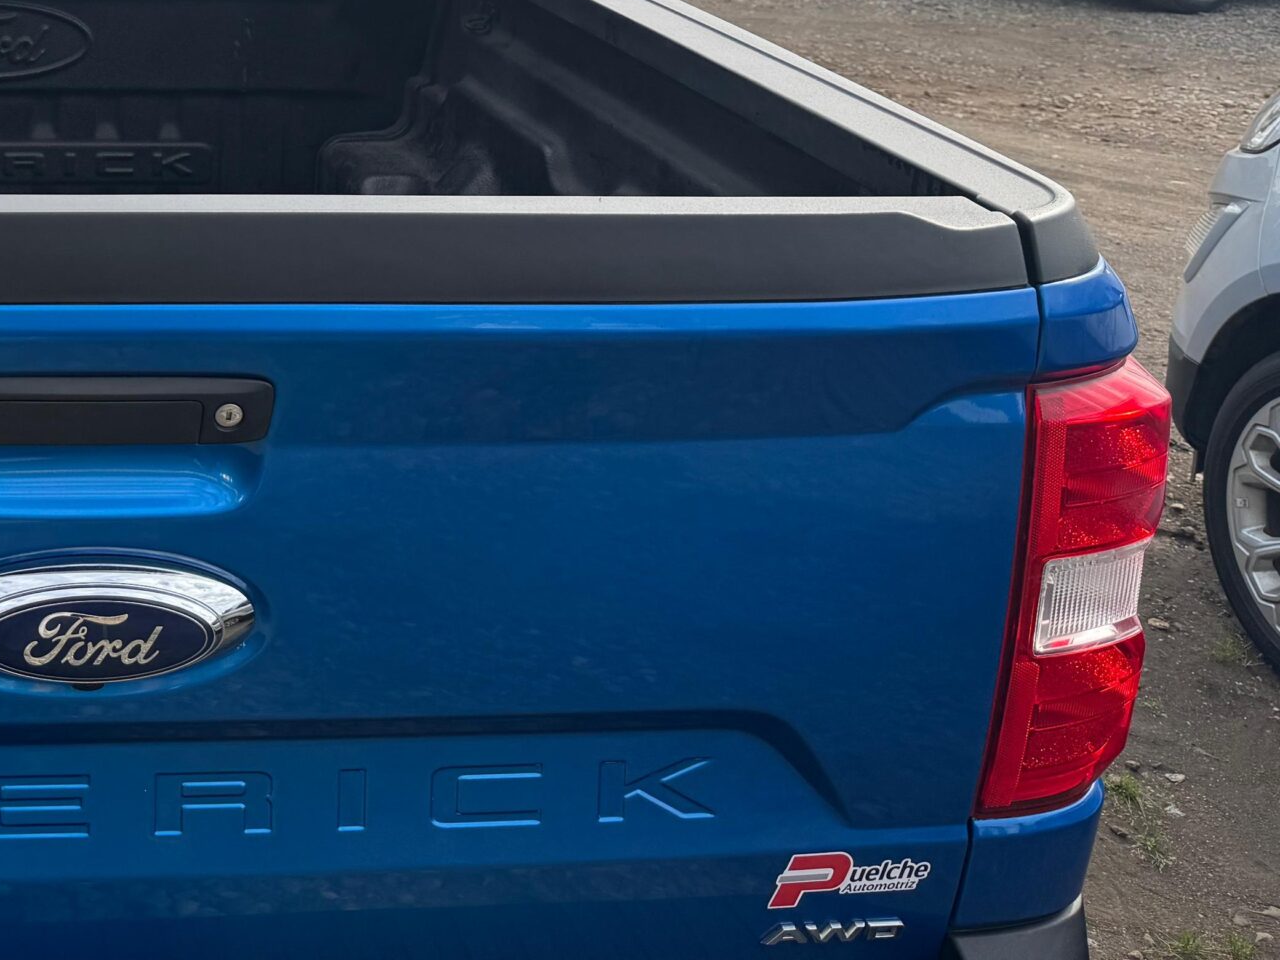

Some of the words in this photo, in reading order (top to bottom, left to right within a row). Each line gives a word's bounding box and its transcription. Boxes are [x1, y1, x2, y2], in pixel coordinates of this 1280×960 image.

[22, 610, 165, 667] Ford
[841, 880, 917, 894] Automotriz
[760, 916, 905, 945] AWD
